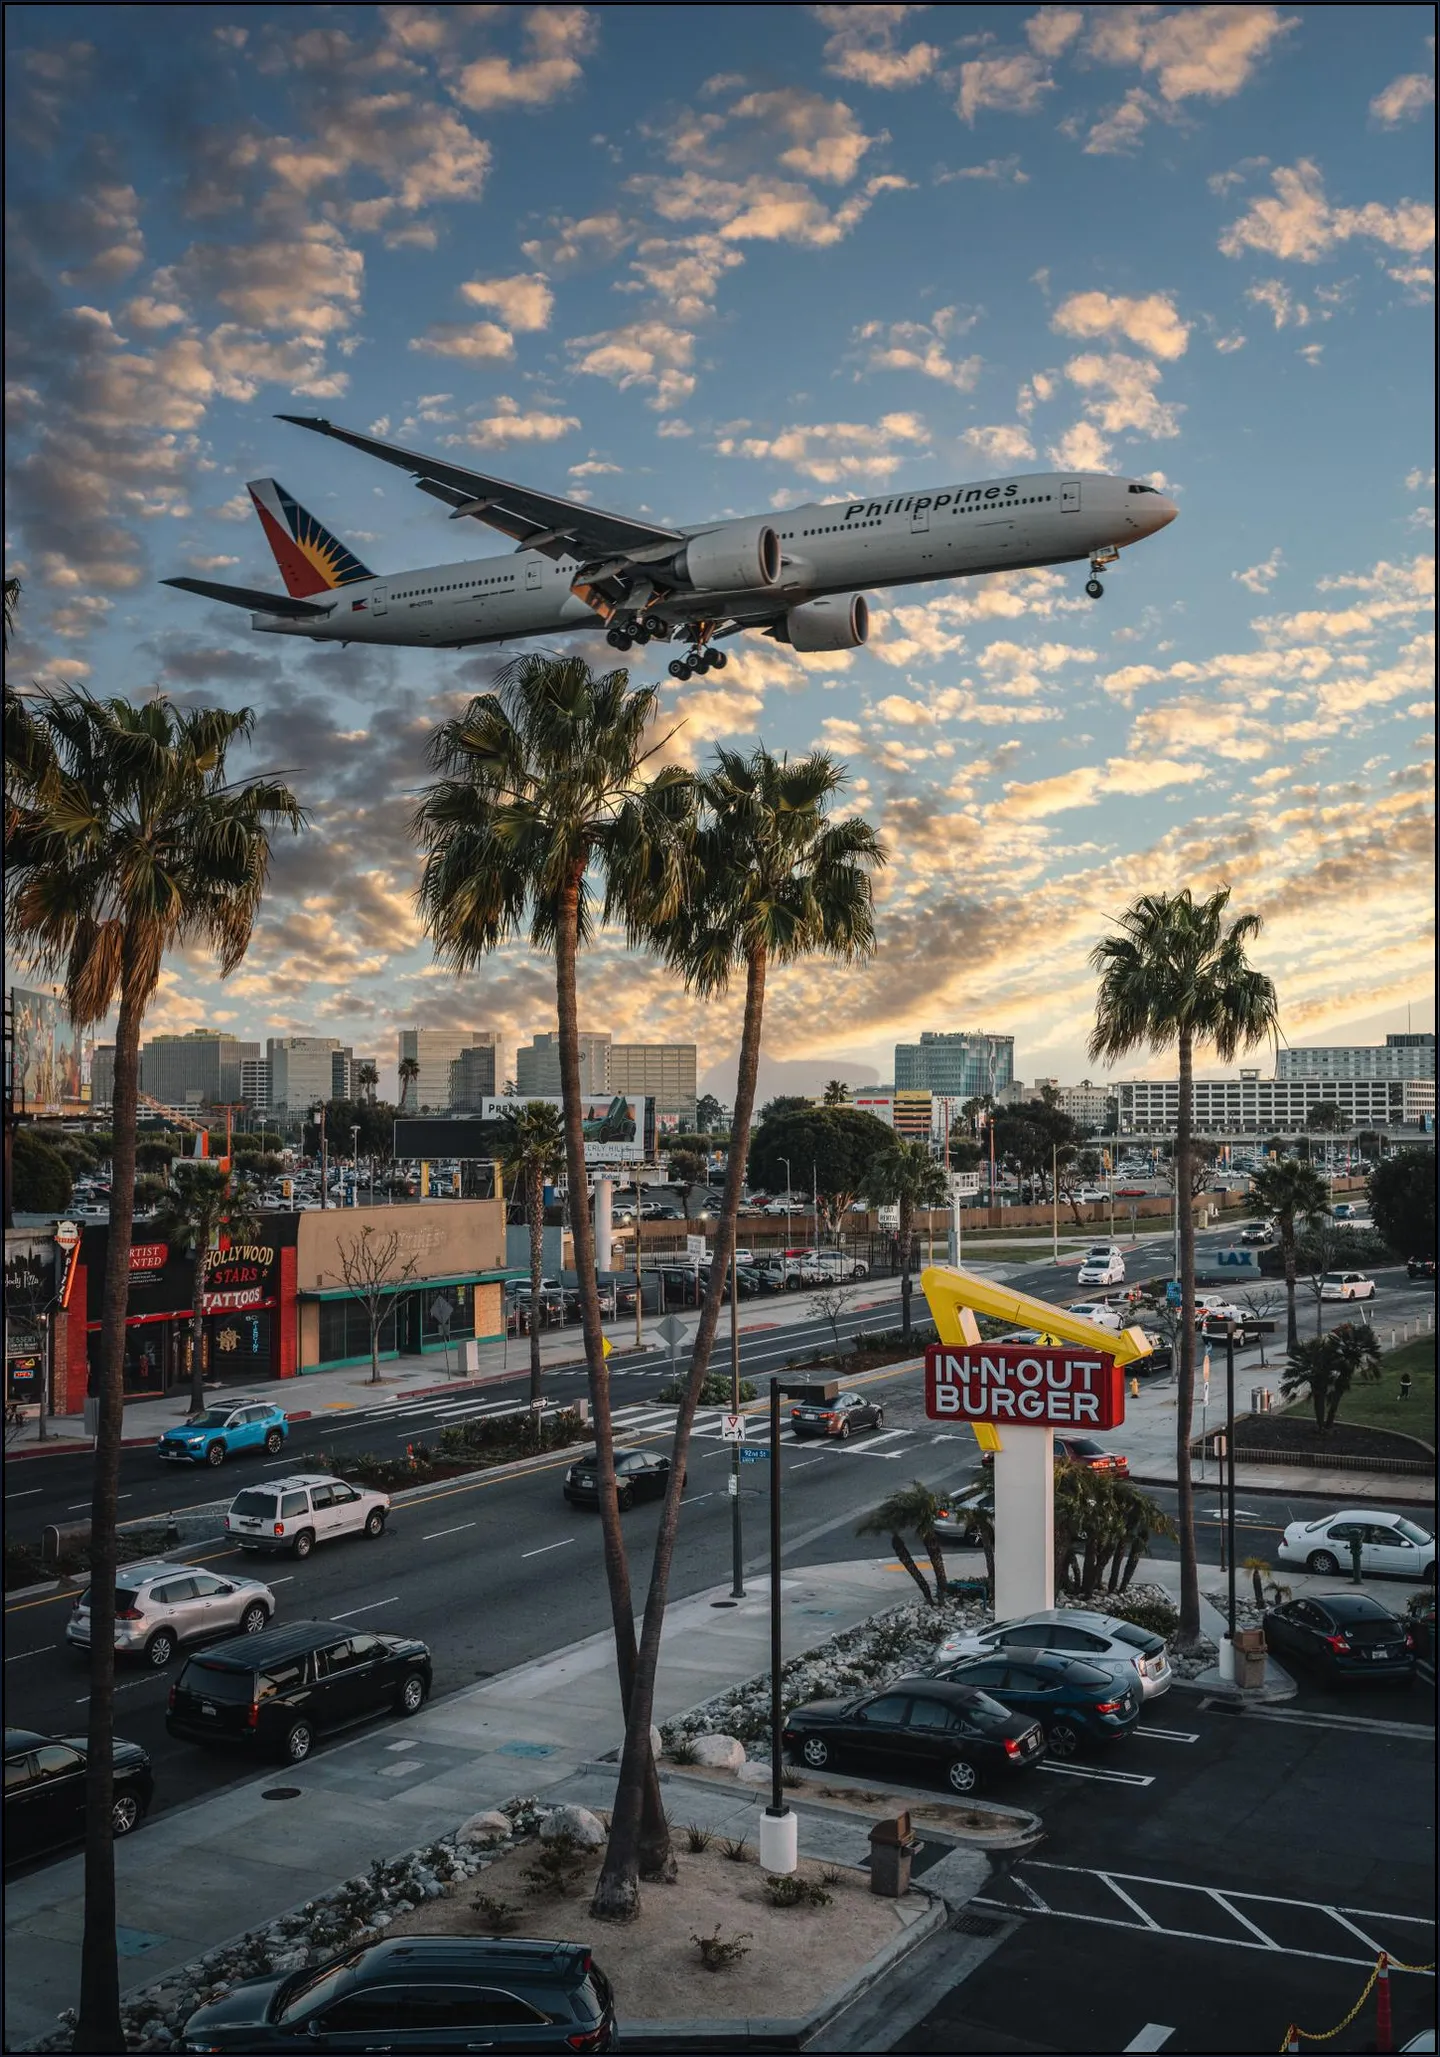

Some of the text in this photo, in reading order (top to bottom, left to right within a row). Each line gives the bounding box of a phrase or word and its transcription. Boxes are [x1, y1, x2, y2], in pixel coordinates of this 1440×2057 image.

[844, 484, 1018, 520] Philippines
[129, 1246, 160, 1257] RTIST
[205, 1245, 274, 1271] HOLLYWOOD
[1217, 1251, 1253, 1266] LAX
[214, 1267, 258, 1284] STARS
[202, 1288, 260, 1308] TATTOOS
[935, 1354, 1101, 1390] IN-N-OUT
[935, 1384, 1100, 1422] BURGER
